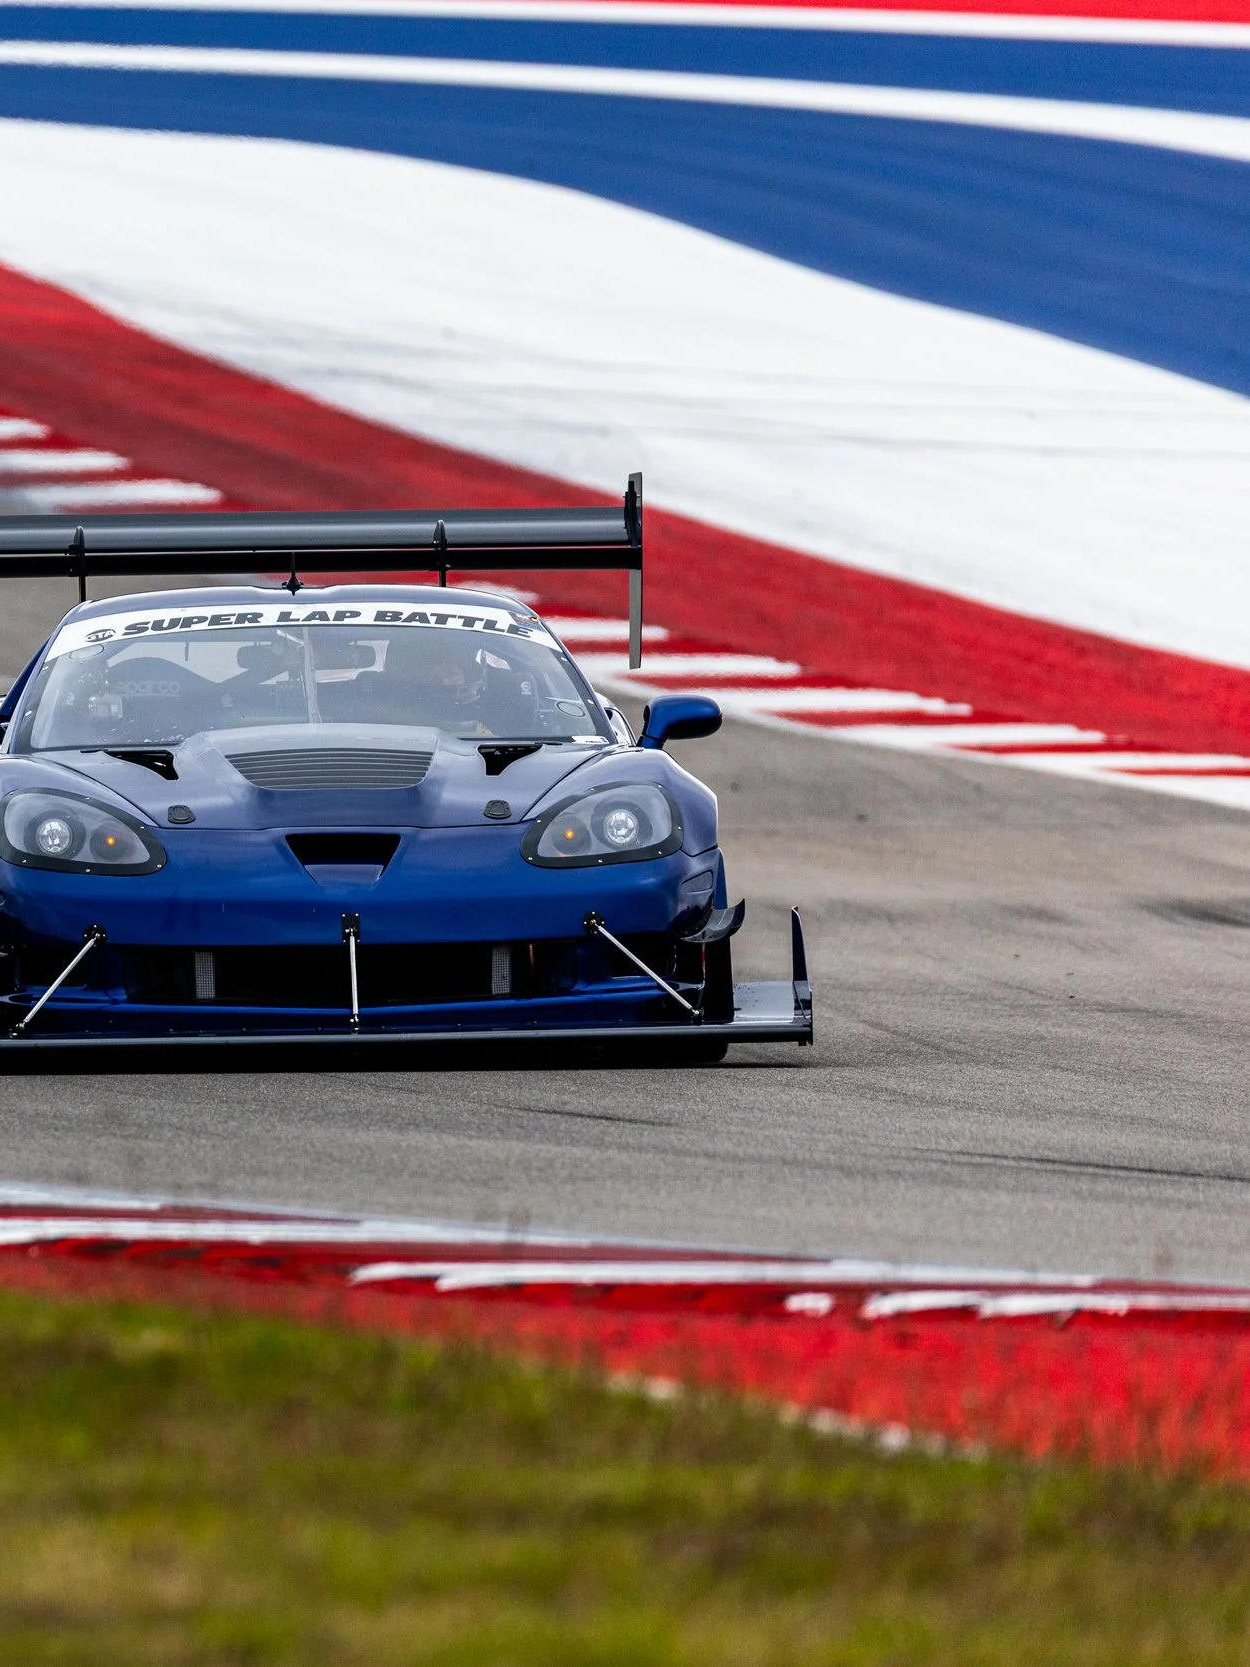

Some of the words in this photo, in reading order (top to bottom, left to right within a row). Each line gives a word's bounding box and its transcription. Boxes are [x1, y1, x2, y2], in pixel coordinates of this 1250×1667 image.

[85, 629, 116, 642] GTA
[122, 612, 264, 636] SUPER
[276, 610, 362, 623] LAP
[373, 610, 533, 638] BATTLE
